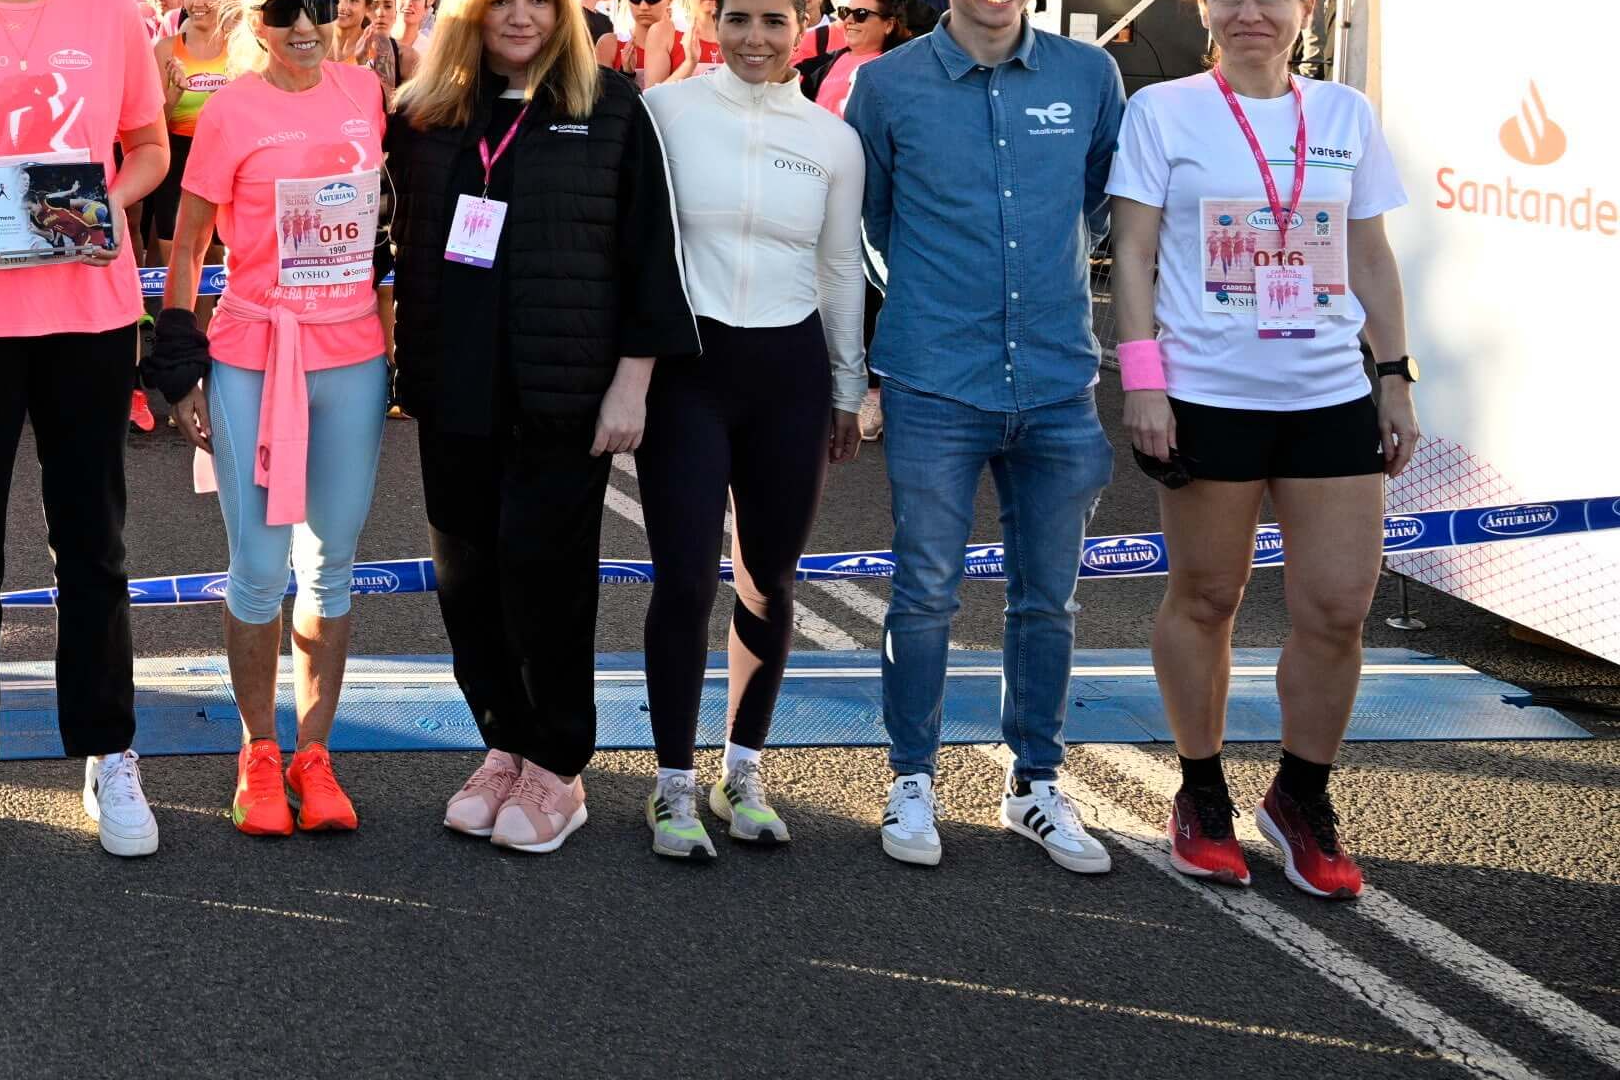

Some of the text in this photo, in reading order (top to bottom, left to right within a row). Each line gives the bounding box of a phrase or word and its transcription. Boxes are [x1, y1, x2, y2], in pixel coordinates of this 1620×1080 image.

[1308, 145, 1353, 160] vareser
[773, 158, 822, 177] OYSHO
[319, 222, 359, 243] 016
[292, 270, 330, 280] OYSHO
[1484, 511, 1553, 529] ASTURIANA
[1089, 550, 1155, 565] ASTURIANA
